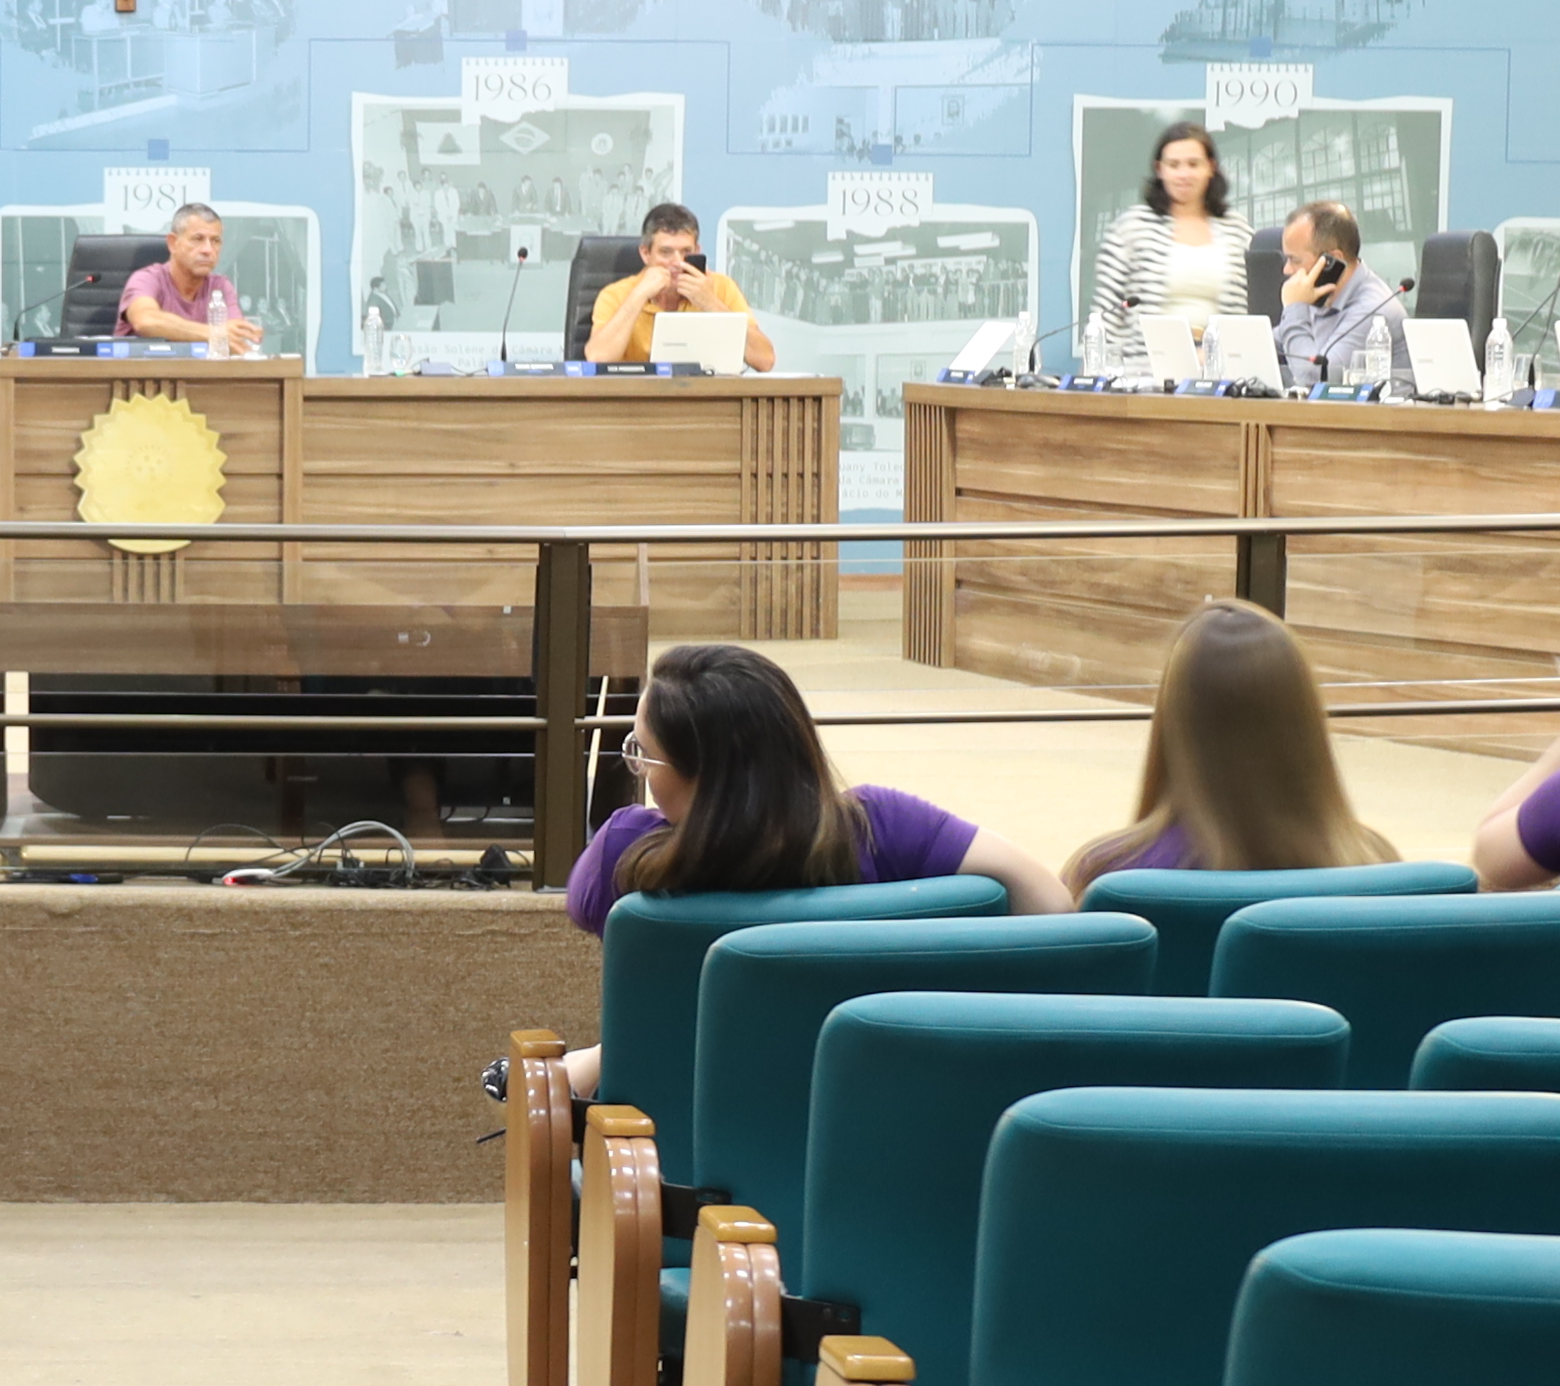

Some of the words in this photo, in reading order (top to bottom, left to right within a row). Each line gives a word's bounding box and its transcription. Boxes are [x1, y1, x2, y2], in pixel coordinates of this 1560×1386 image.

[474, 73, 552, 102] 1986
[1215, 79, 1298, 108] 1990
[123, 182, 187, 212] 1981
[841, 187, 919, 216] 1988
[512, 344, 553, 355] Câmara
[859, 474, 899, 485] Câmara
